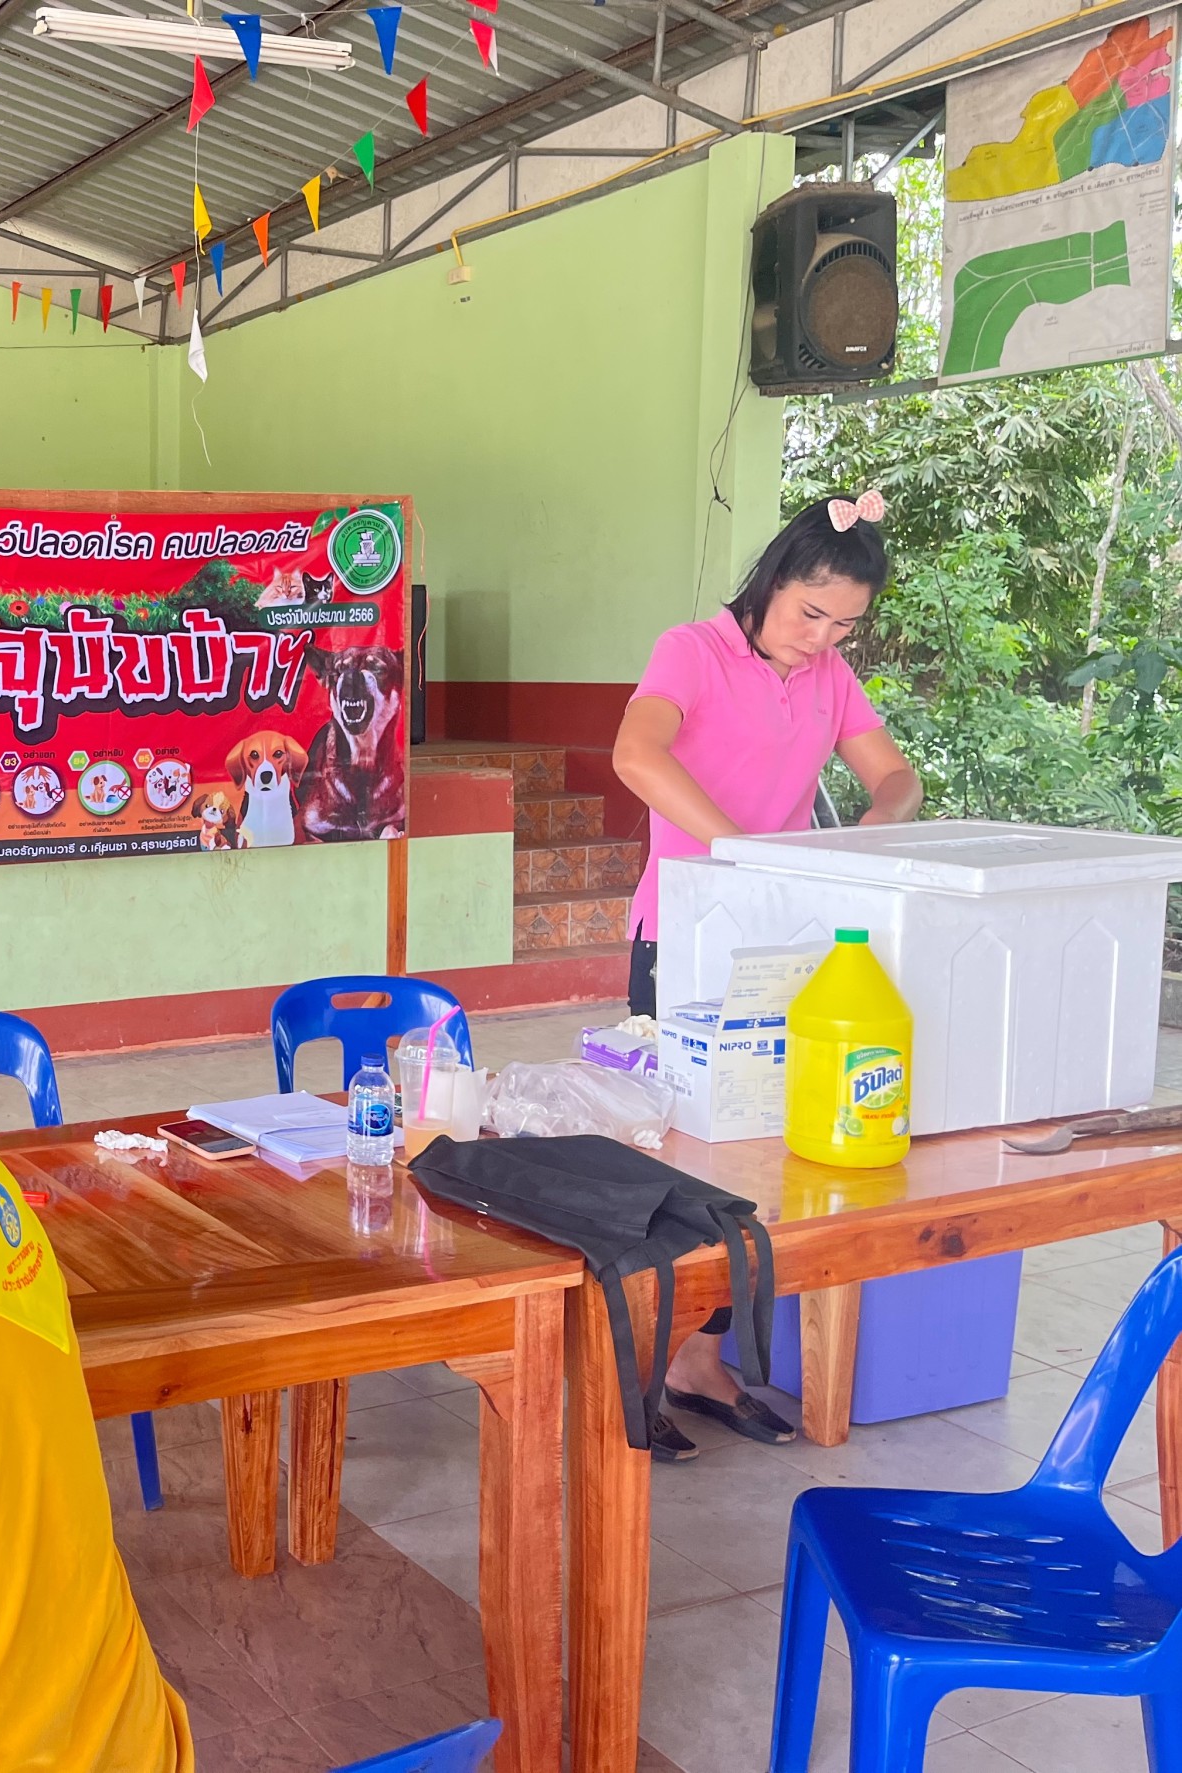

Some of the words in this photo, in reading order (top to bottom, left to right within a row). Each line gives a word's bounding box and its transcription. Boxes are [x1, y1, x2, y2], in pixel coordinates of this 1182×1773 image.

[163, 521, 308, 558] คนปลอดภัย
[267, 608, 346, 626] ประจำปีงบประมาณ
[349, 608, 374, 622] 2566
[79, 841, 127, 854] อ.เคียนซา
[130, 836, 198, 852] จ.สุราษฎร์ธานี
[719, 1041, 752, 1052] NIPRO
